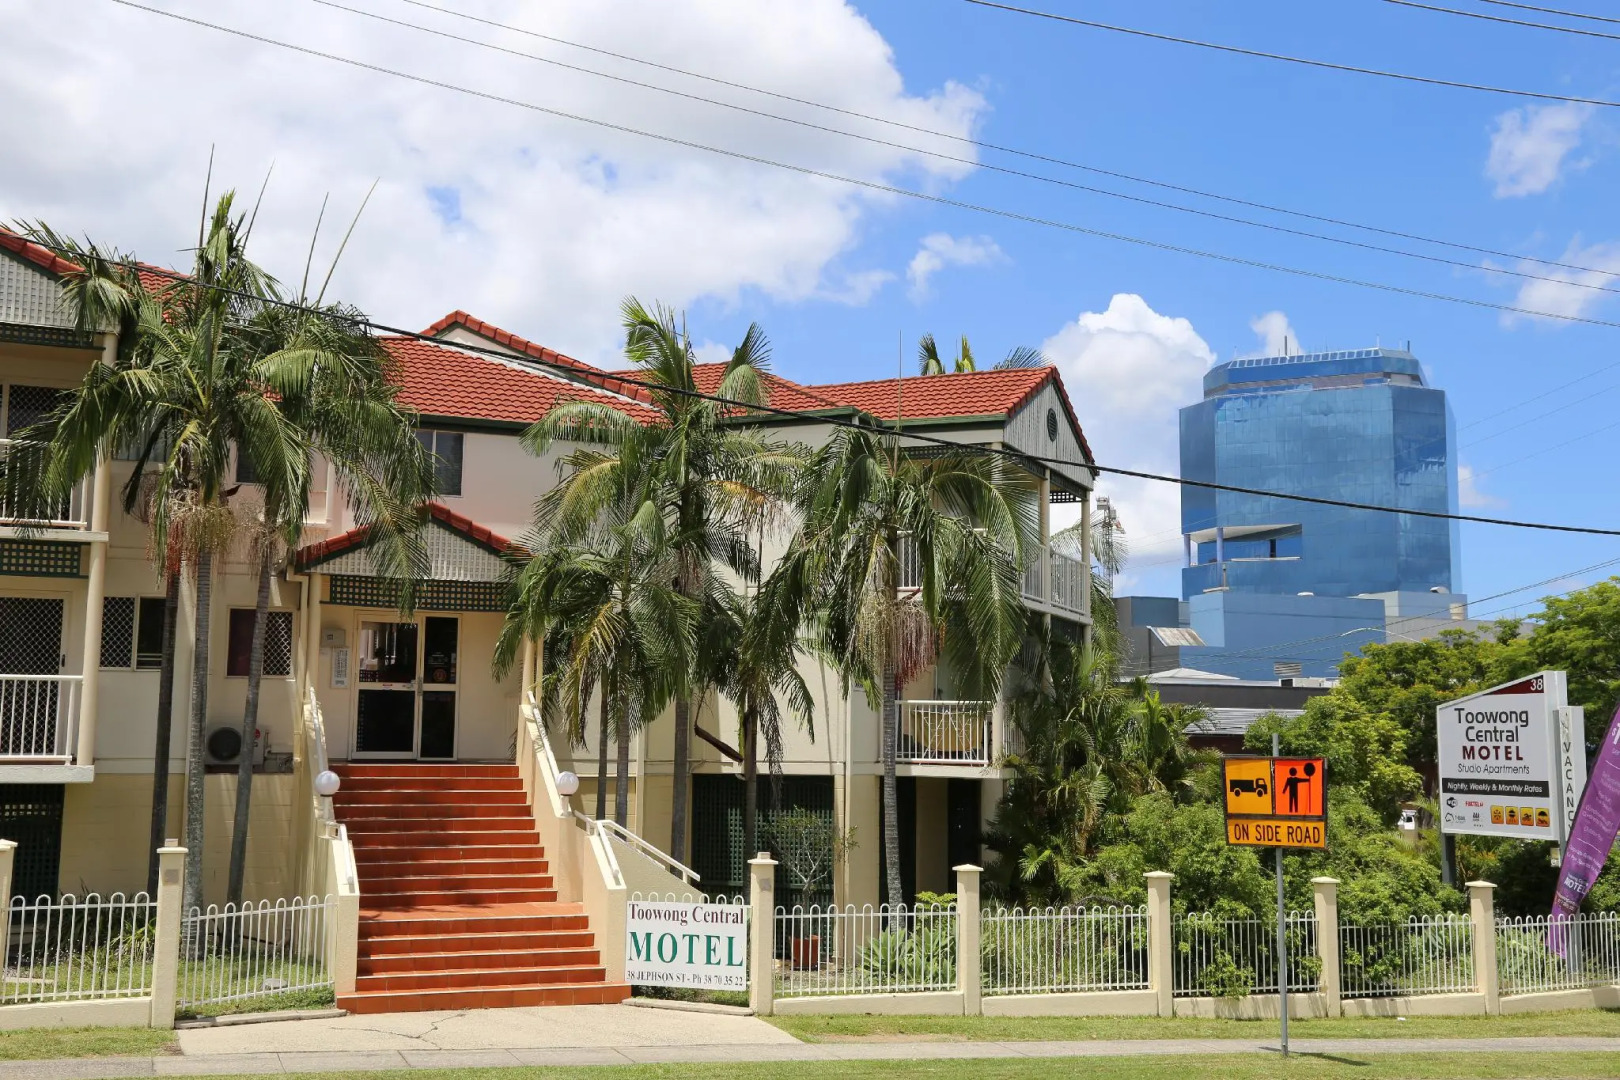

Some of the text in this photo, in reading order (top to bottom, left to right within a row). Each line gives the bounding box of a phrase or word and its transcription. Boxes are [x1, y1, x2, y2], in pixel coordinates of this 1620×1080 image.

[1530, 678, 1543, 691] 38
[1454, 708, 1528, 727] Toowong
[1465, 726, 1519, 743] Central
[1462, 745, 1524, 761] MOTEL
[1457, 763, 1530, 776] Studio Apartments
[1469, 783, 1491, 792] Weekly
[1498, 784, 1523, 793] Monthly
[1234, 823, 1320, 844] ON SIDE ROAD
[629, 903, 744, 926] Toowong Central
[628, 931, 744, 967] MOTEL
[627, 970, 636, 980] 38
[636, 971, 675, 982] JEPHSON
[676, 973, 687, 983] ST
[692, 974, 702, 984] Ph
[703, 975, 712, 985] 38
[714, 975, 723, 985] 70
[724, 976, 733, 986] 35
[734, 977, 744, 987] 22
